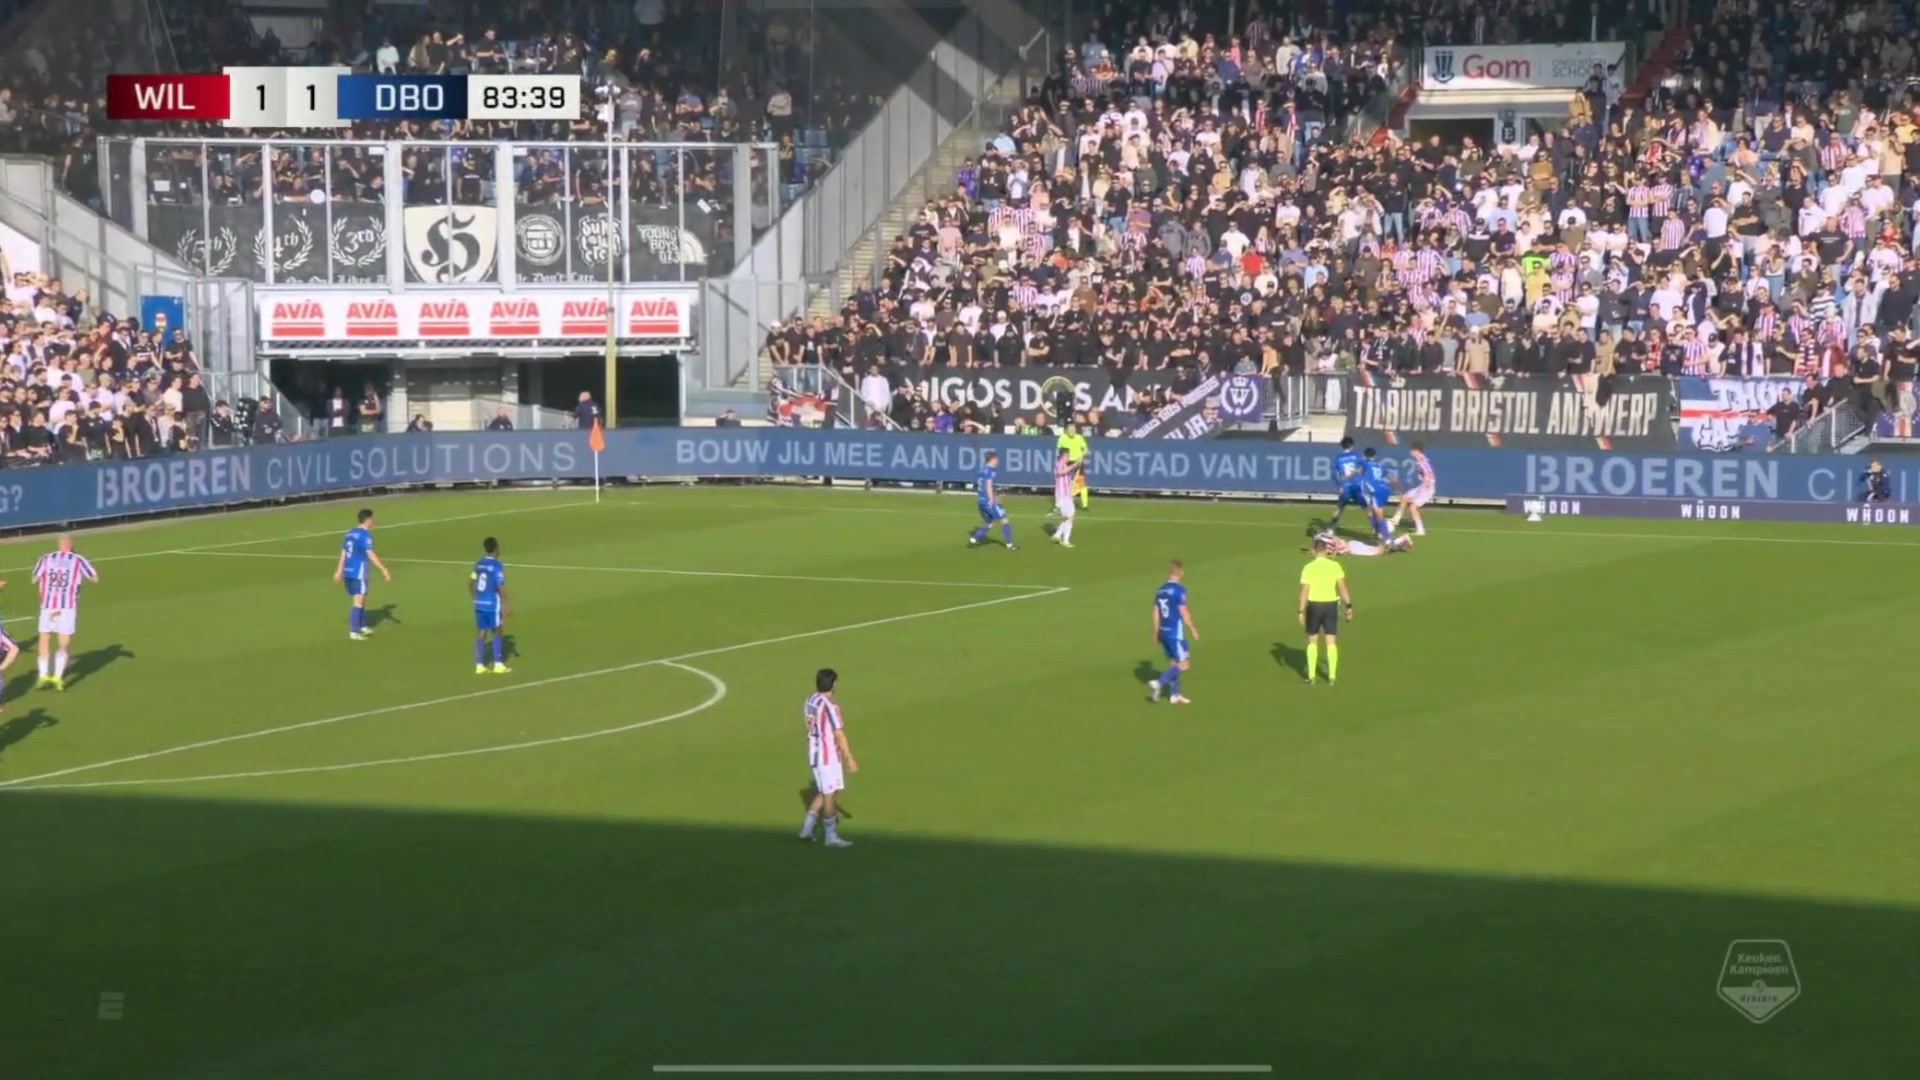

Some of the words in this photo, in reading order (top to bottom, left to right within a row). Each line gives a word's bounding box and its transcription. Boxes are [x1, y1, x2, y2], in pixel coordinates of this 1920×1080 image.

[1462, 53, 1530, 79] Gom
[1552, 67, 1592, 78] SCHO
[1353, 385, 1442, 431] TILBURG
[1450, 389, 1539, 434] BRISTOL
[676, 439, 769, 464] BOUW
[778, 440, 815, 465] JIJ
[824, 442, 882, 467] MEE
[891, 444, 948, 470] AAN
[1006, 448, 1190, 477] BINENSTAD
[1199, 453, 1257, 480] VAN
[97, 455, 250, 510] BROEREN
[266, 455, 338, 489] CIVIL
[350, 442, 575, 480] SOLUTIONS
[1526, 454, 1778, 499] BROEREN
[1681, 501, 1741, 519] WHOON
[1846, 506, 1910, 524] WHOON
[477, 572, 488, 592] 6
